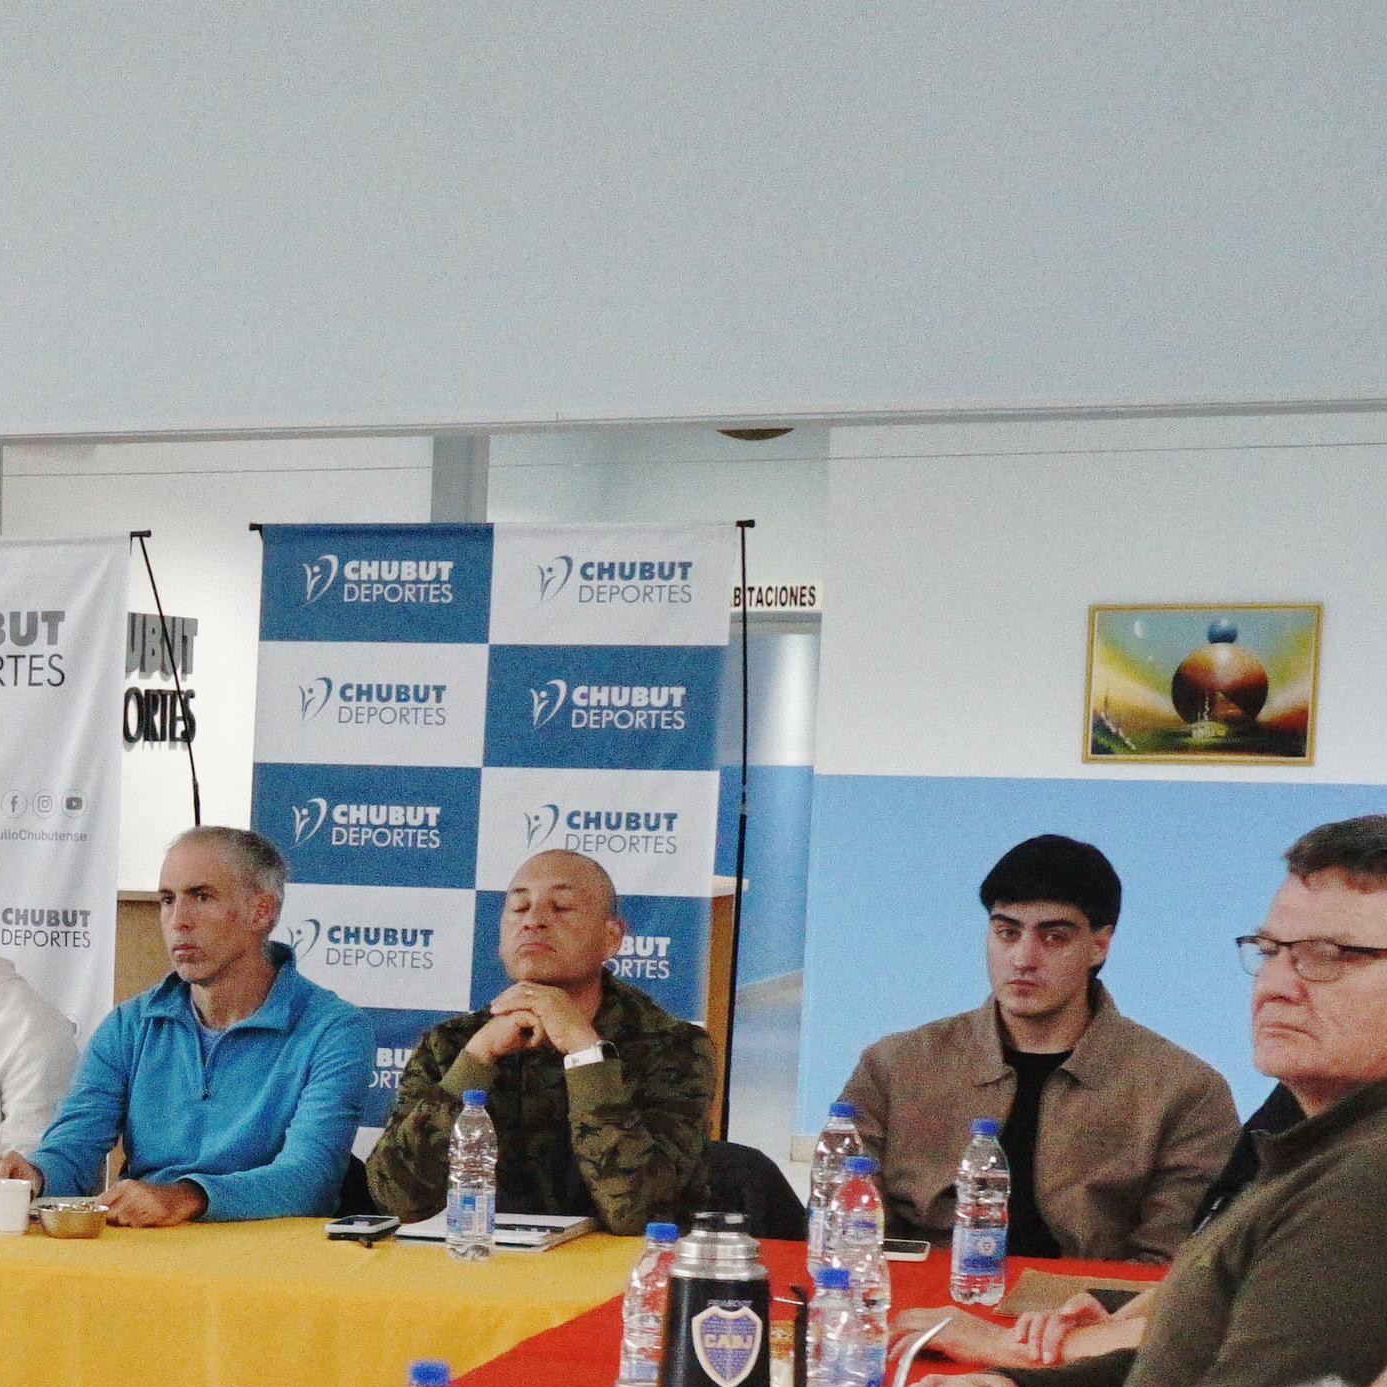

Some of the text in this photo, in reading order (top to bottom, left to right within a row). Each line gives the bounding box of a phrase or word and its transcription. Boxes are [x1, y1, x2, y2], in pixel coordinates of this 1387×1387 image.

[344, 560, 453, 581] CHUBUT
[579, 561, 692, 581] CHUBUT
[343, 584, 453, 604] DEPORTES
[579, 584, 692, 603] DEPORTES
[731, 585, 817, 607] BTACIONES
[126, 611, 198, 676] UBUT
[339, 683, 446, 703] CHUBUT
[572, 685, 686, 707] CHUBUT
[123, 687, 196, 744] ORTES
[338, 706, 446, 725] DEPORTES
[571, 709, 686, 730] DEPORTES
[332, 804, 441, 826] CHUBUT
[566, 810, 677, 832] CHUBUT
[331, 827, 440, 848] DEPORTES
[565, 834, 677, 854] DEPORTES
[2, 907, 91, 927] CHUBUT
[1, 928, 91, 948] DEPORTES
[327, 925, 433, 947] CHUBUT
[617, 935, 671, 957] BUT
[326, 948, 433, 969] DEPORTES
[602, 959, 670, 979] ORTES
